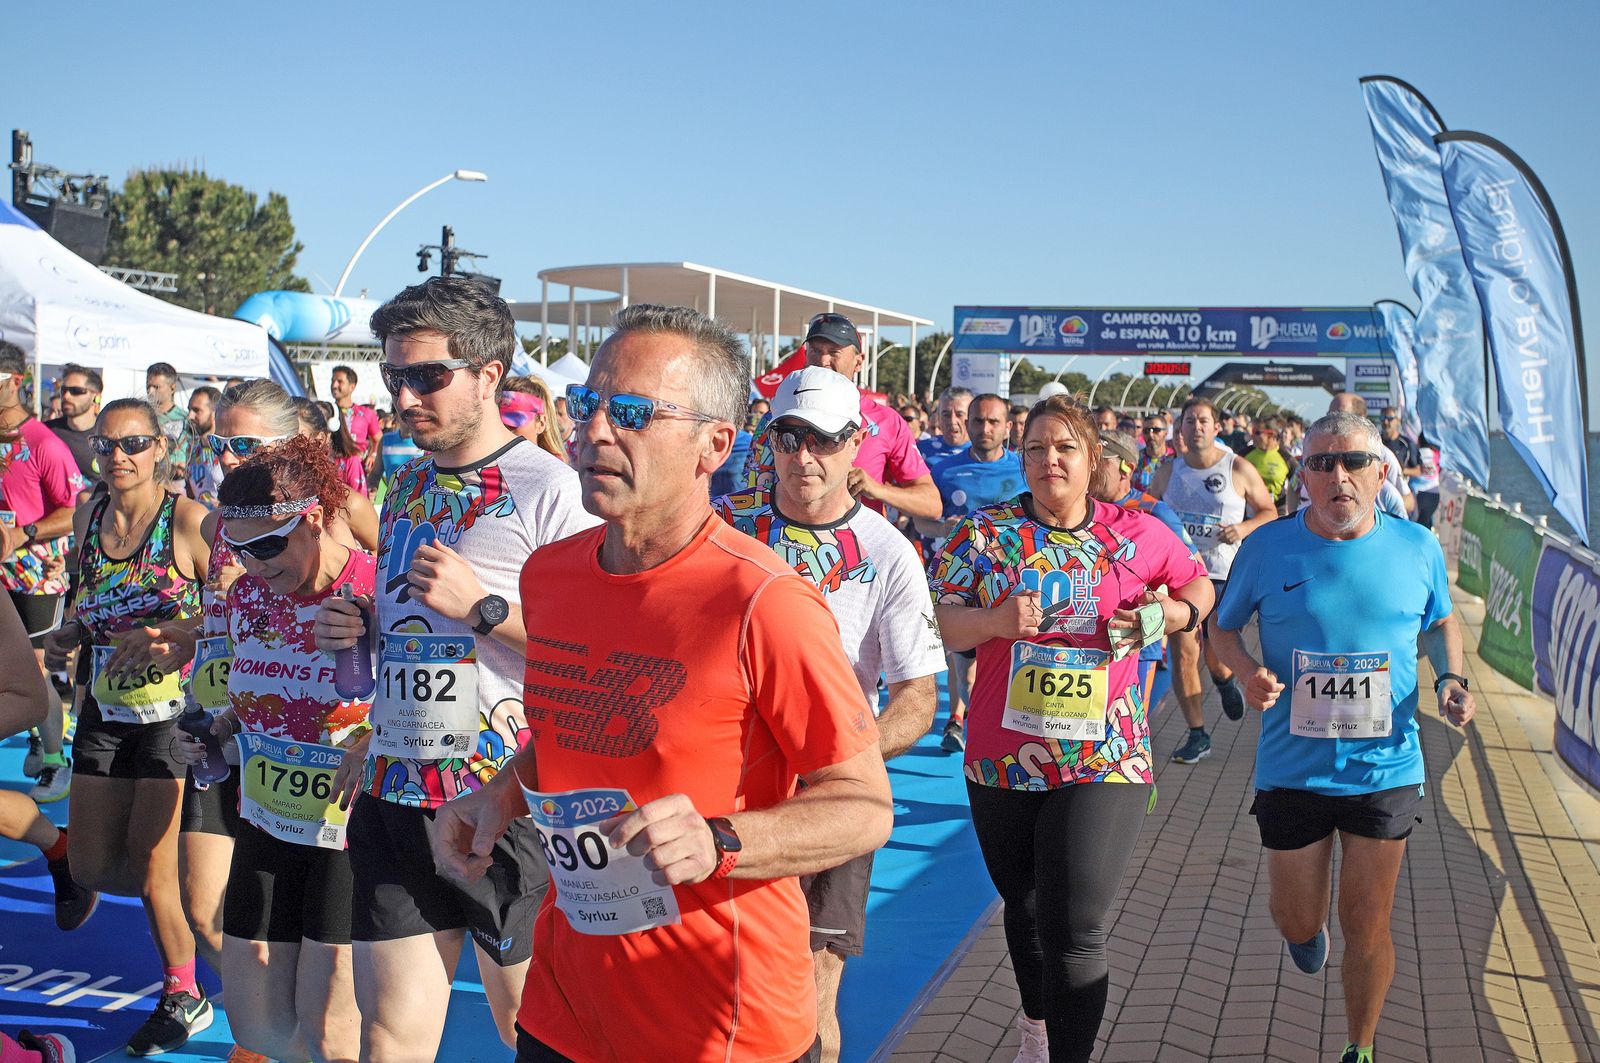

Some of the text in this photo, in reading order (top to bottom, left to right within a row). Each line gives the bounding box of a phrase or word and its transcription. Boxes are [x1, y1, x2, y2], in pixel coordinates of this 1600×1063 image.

[1101, 312, 1203, 326] CAMPEONATO
[1100, 324, 1238, 342] de ESPAÑA 10 km
[1276, 322, 1318, 337] HUELVA
[1148, 342, 1164, 350] ruta
[1201, 343, 1207, 351] y
[1072, 569, 1101, 586] HU
[77, 582, 146, 613] HUELVA
[1072, 585, 1100, 601] EL
[79, 594, 160, 626] UNNERS
[1072, 600, 1099, 617] VA
[1074, 654, 1099, 666] 2023
[1309, 661, 1331, 669] HUELVA
[1353, 658, 1380, 670] 2023
[233, 656, 312, 682] WOM@N'S
[383, 666, 457, 702] 1182
[1025, 669, 1092, 699] 1625
[1305, 676, 1371, 700] 1441
[1060, 711, 1088, 720] LOZANO
[402, 721, 446, 730] CARNACEA
[1044, 721, 1072, 732] Syrluz
[1331, 722, 1358, 731] Syrluz
[261, 741, 283, 756] HUELVA
[403, 736, 434, 747] Syrluz
[257, 760, 333, 800] 1796
[263, 802, 314, 822] TENORIO CRUZ
[271, 798, 302, 811] AMPARO
[571, 796, 620, 820] 2023
[275, 820, 305, 835] Syrluz
[560, 878, 599, 891] MANUEL
[590, 885, 639, 902] VASALLO
[578, 909, 618, 924] Syrluz
